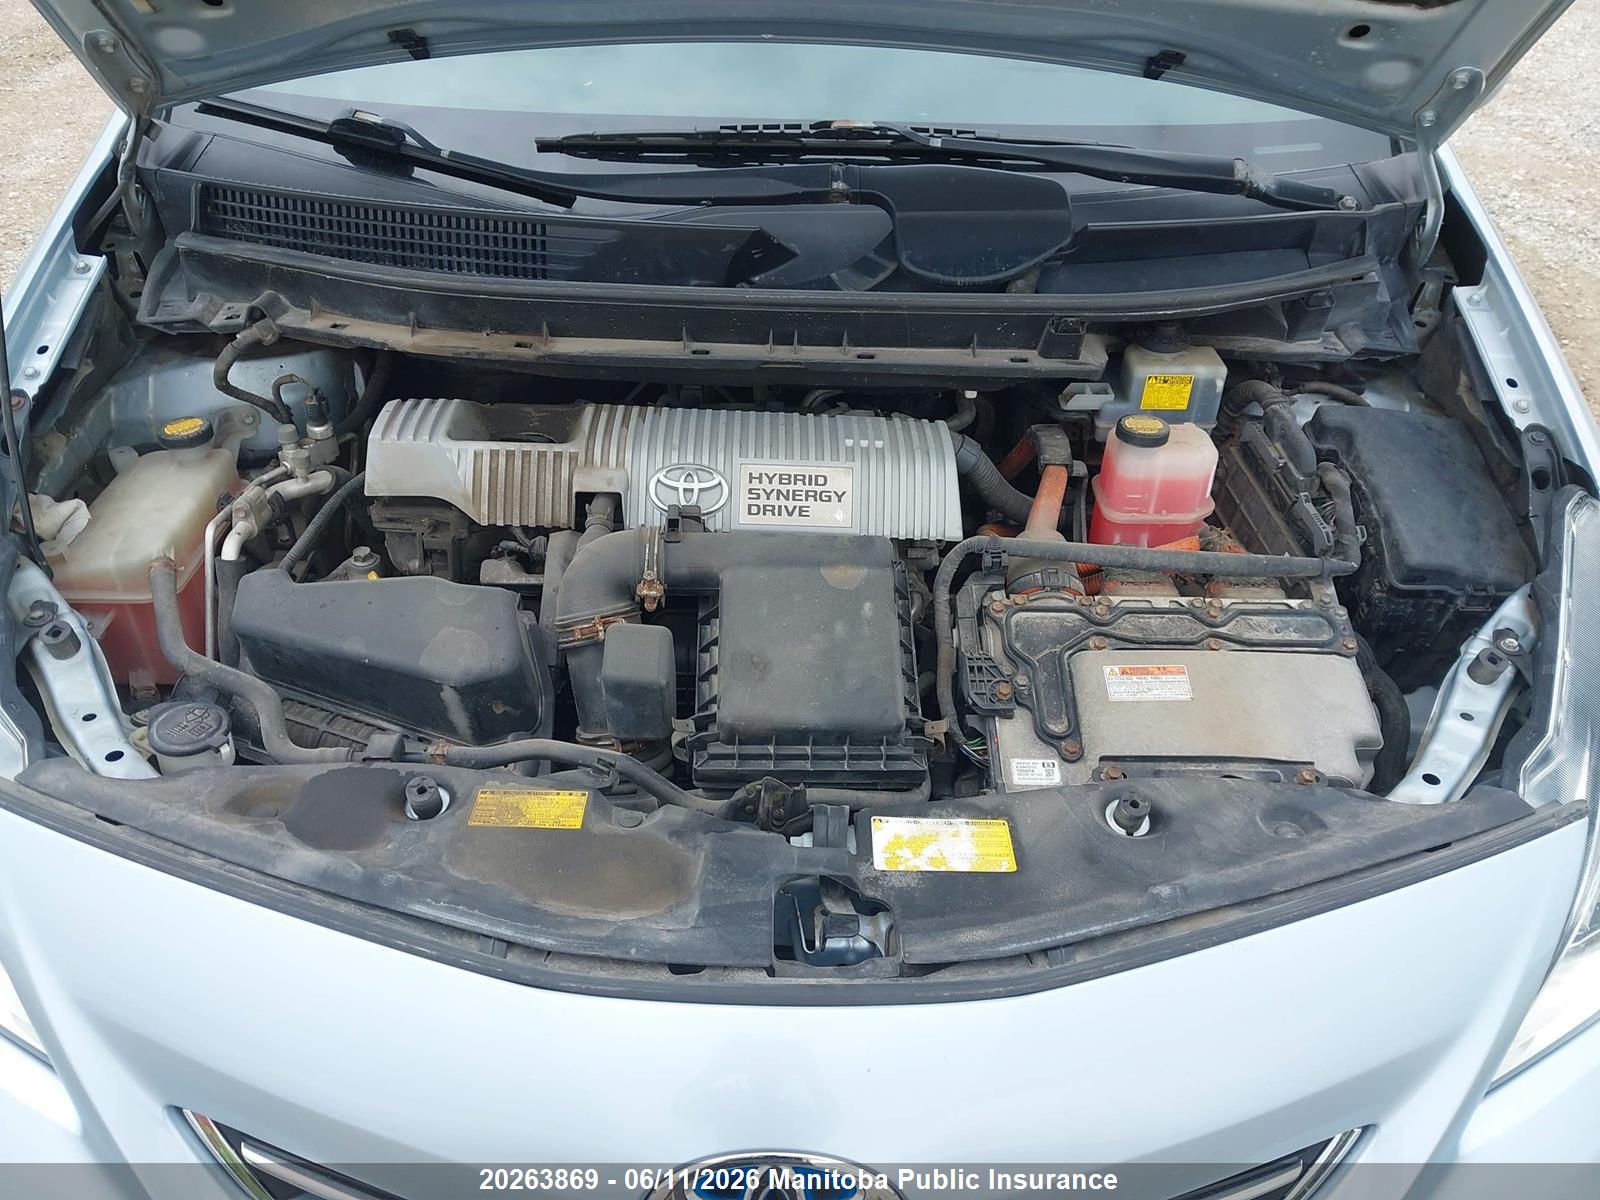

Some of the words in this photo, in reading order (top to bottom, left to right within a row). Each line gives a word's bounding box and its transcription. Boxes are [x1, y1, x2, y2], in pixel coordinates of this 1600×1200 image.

[748, 472, 828, 487] HYBRID
[747, 487, 847, 503] SYNERGY
[747, 503, 811, 517] DRIVE
